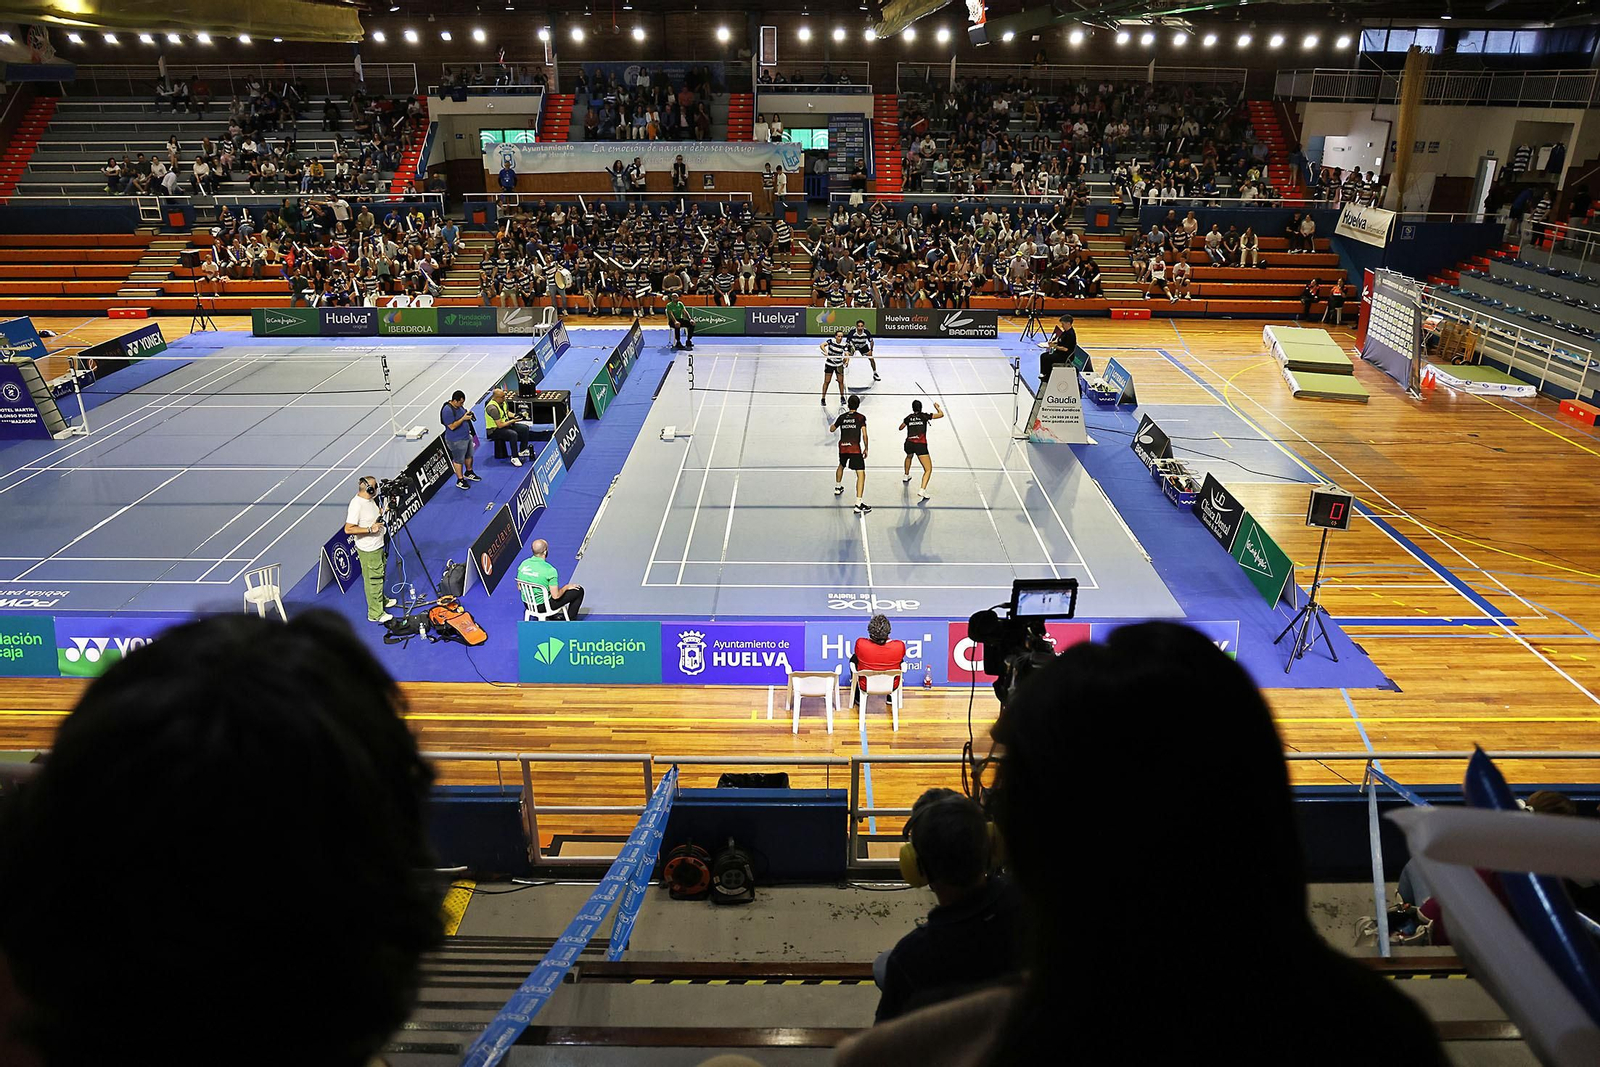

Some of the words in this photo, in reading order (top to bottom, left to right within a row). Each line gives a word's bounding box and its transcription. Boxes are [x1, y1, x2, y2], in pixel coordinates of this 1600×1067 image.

[522, 144, 574, 152] Ayuntamiento
[592, 143, 605, 153] La
[647, 142, 656, 152] de
[1342, 209, 1367, 230] Huelva
[325, 312, 367, 324] Huelva
[752, 311, 795, 324] Huelva
[885, 314, 910, 322] Huelva
[388, 325, 433, 333] IBERDROLA
[139, 331, 164, 351] YONEX
[1046, 395, 1077, 405] Gaudia
[1329, 502, 1345, 520] 0
[487, 523, 512, 558] enclave
[26, 589, 70, 597] bebida
[569, 638, 646, 652] Fundación
[713, 640, 776, 650] Ayuntamiento
[777, 640, 790, 648] de
[569, 652, 625, 669] Unicaja
[712, 651, 790, 667] HUELVA
